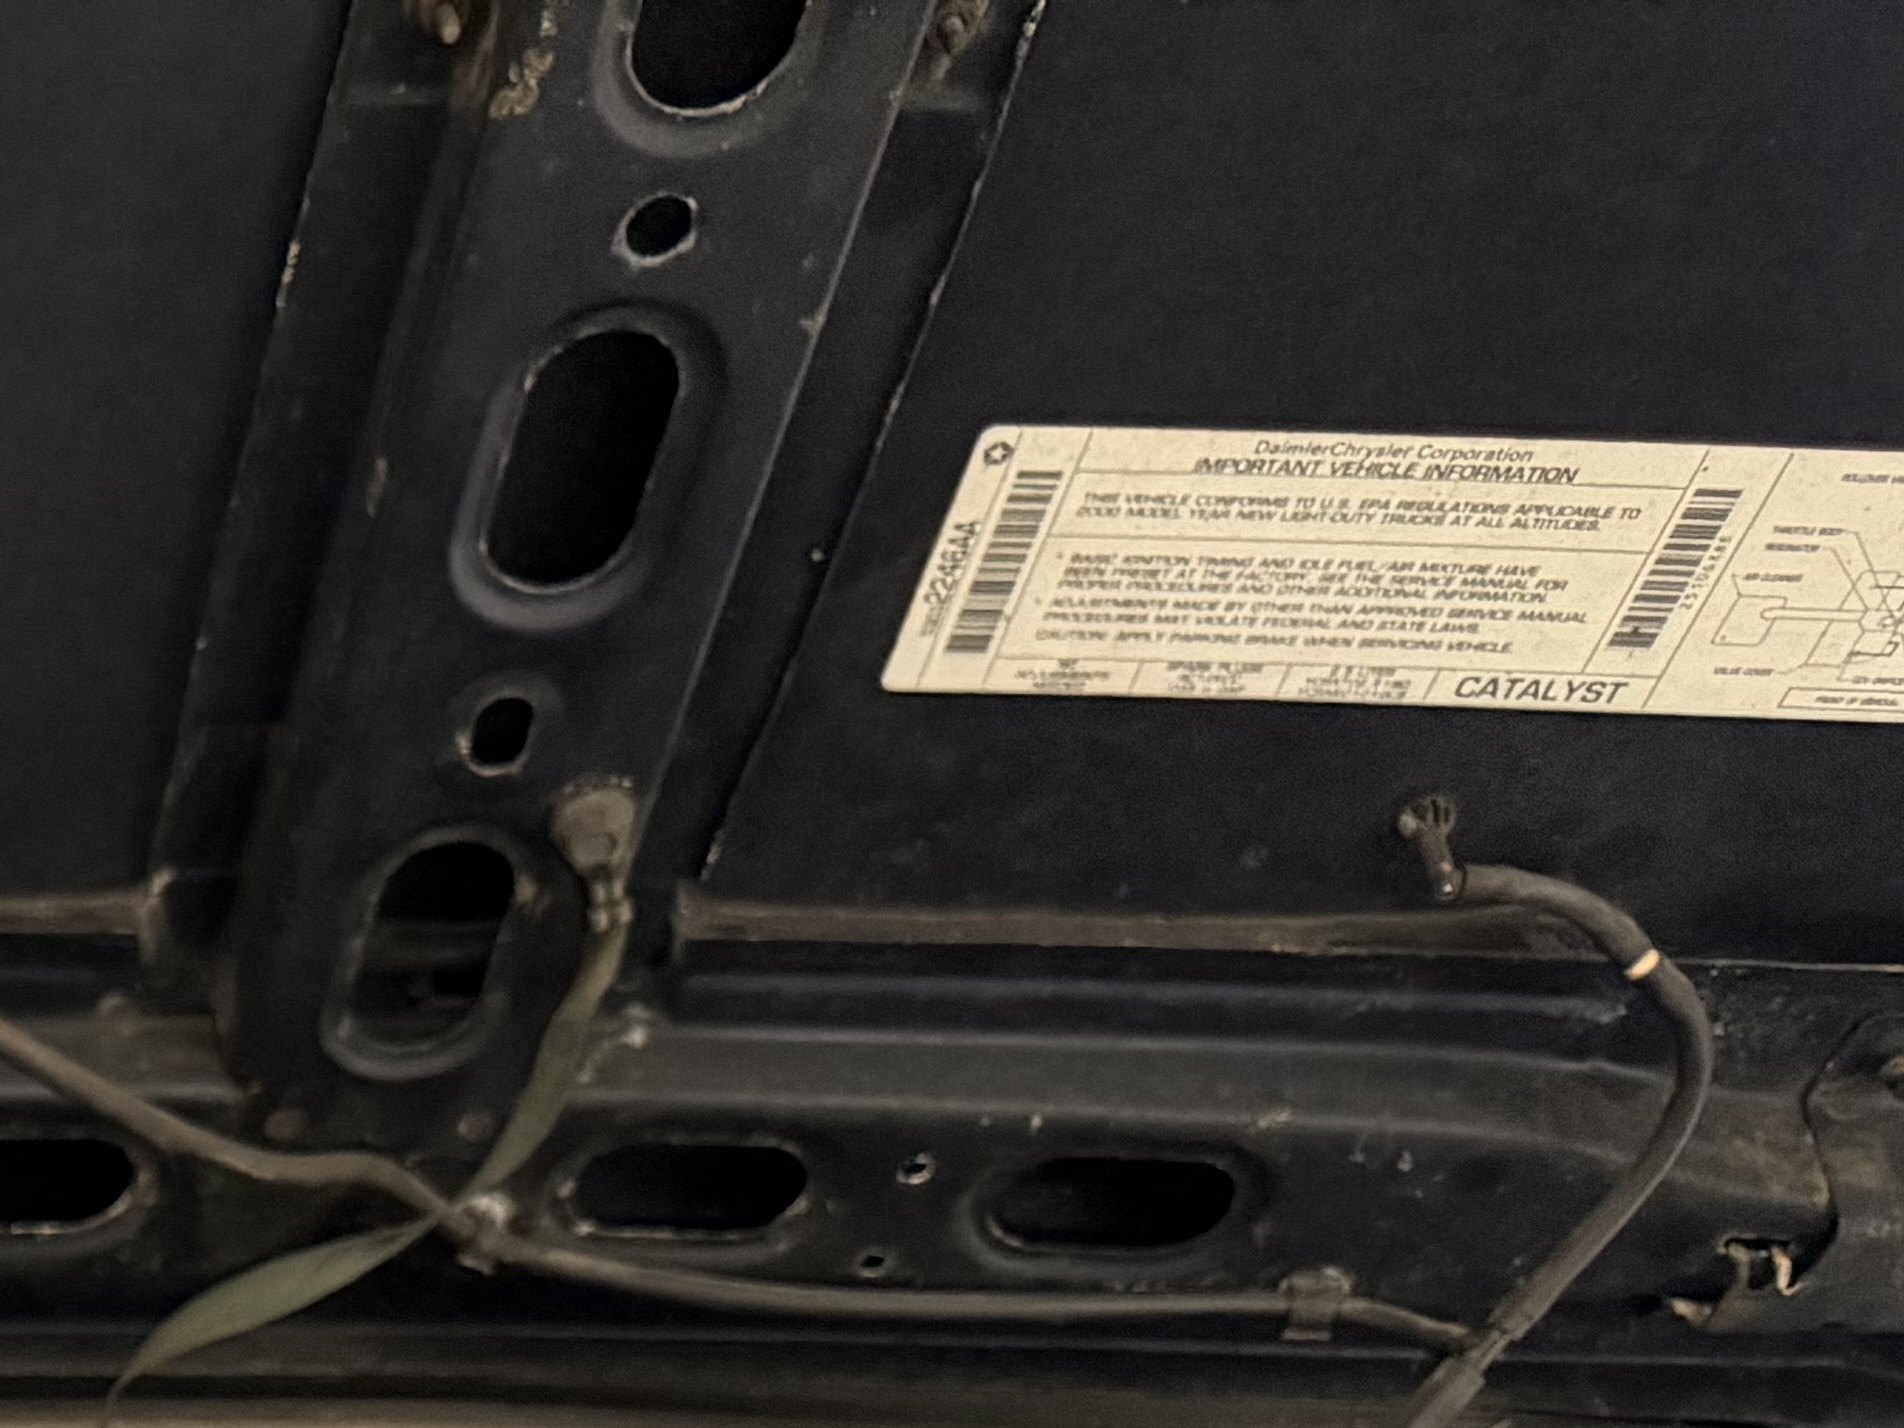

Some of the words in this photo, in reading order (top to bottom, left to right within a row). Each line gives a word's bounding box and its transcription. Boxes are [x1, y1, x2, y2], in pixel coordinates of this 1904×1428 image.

[1254, 439, 1413, 460] DaimlerChrysler
[1416, 444, 1535, 463] Corporation
[1194, 456, 1322, 476] IMPORTANT
[1328, 460, 1418, 479] VEHICLE
[1423, 462, 1579, 484] INFORMATION
[1125, 492, 1190, 504] VEHICLE
[1195, 494, 1289, 507] CONFORMS
[1296, 497, 1314, 508] TO
[1359, 498, 1390, 510] EPA
[1396, 499, 1509, 514] REGULATIONS
[1514, 503, 1613, 518] APPLICABLE
[1619, 507, 1641, 519] TO
[1236, 509, 1275, 521] NEW
[1382, 512, 1446, 526] TRUCKS
[1450, 515, 1472, 526] AT
[1476, 516, 1505, 527] ALL
[1258, 558, 1293, 568] AND
[1495, 564, 1540, 577] HAVE
[1391, 575, 1454, 587] SERVICE
[1461, 577, 1528, 589] MANUAL
[1535, 579, 1567, 591] FOR
[1447, 608, 1512, 620] SERVICE
[1517, 610, 1588, 623] MANUAL
[1337, 619, 1373, 630] AND
[1377, 620, 1424, 632] STATE
[1454, 676, 1629, 704] CATALYST
